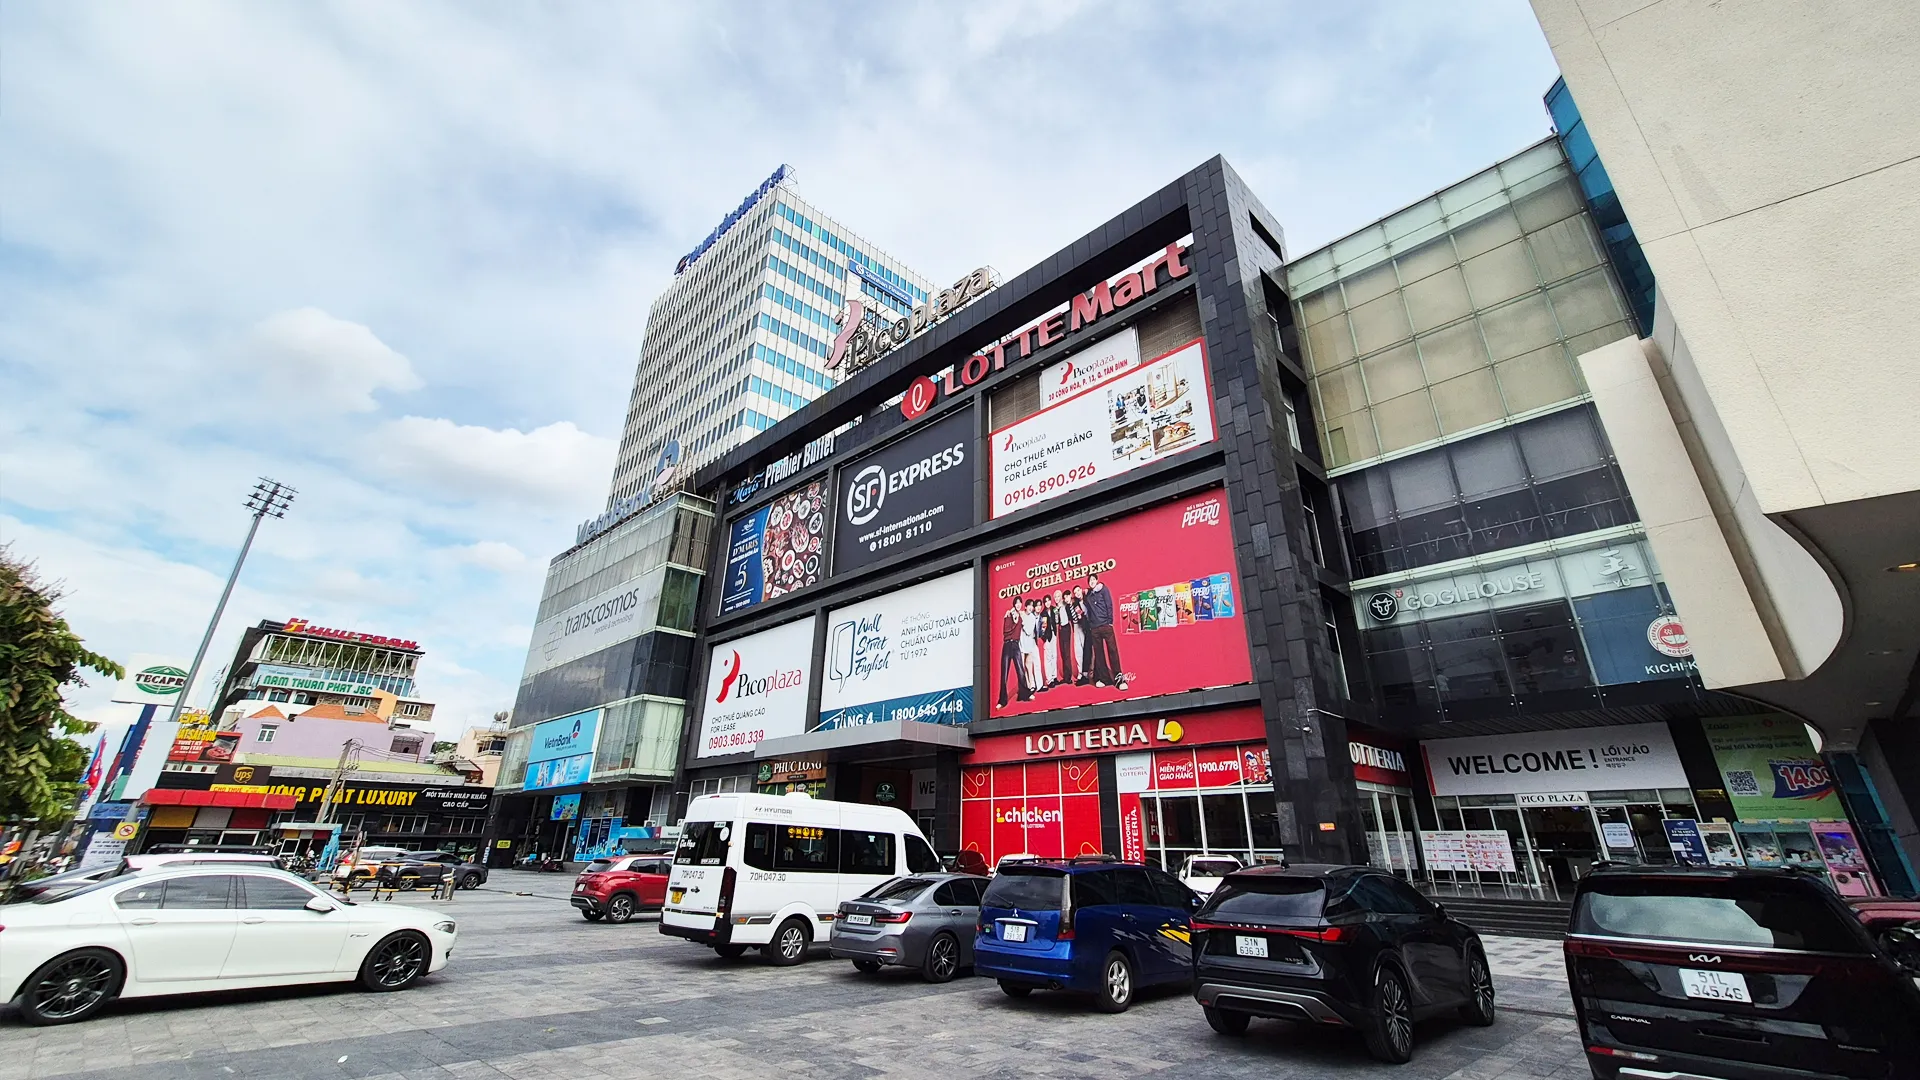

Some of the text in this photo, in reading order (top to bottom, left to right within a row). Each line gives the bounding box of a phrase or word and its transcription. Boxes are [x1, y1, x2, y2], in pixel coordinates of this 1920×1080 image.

[865, 271, 909, 302] Shinhan Finance
[945, 242, 1190, 396] LOTTE Mart
[1048, 393, 1054, 402] 20
[1004, 429, 1093, 472] CHO THUÊ MẶT BẰNG
[764, 452, 803, 489] Premier
[888, 442, 965, 494] EXPRESS
[1004, 460, 1048, 484] FOR LEASE
[1004, 461, 1097, 507] 0916.890.926
[858, 504, 945, 544] www.sf-international.com
[1181, 502, 1220, 529] PEPERO
[877, 521, 932, 549] 1800 8110
[1000, 561, 1016, 570] LOTTE
[1025, 554, 1083, 579] CÙNG VUI
[998, 558, 1117, 599] CÙNG CHIA PEPERO
[1612, 577, 1632, 588] YU
[1404, 571, 1546, 611] GOGI HOUSE
[564, 587, 640, 637] transcosmos
[857, 613, 882, 635] Wall
[900, 610, 975, 638] ANH NGỮ TOÀN CẦU
[927, 631, 948, 644] CHÂU
[948, 627, 960, 638] ÂU
[856, 635, 889, 656] Street
[910, 647, 928, 659] 1972
[1667, 646, 1691, 654] HOTPO
[854, 650, 891, 681] English
[135, 673, 188, 687] TECAPR
[263, 675, 373, 696] NAM THUAN PHAT JSC
[735, 669, 802, 699] Picoplaza
[711, 715, 722, 725] CHO
[722, 711, 735, 723] THUÊ
[890, 705, 916, 721] 1800
[710, 722, 736, 734] FOR LEASE
[708, 728, 765, 750] 0903.960.339
[1024, 722, 1150, 755] LOTTERIA
[1348, 741, 1406, 772] OTTERIA
[1600, 743, 1650, 756] LỐI VÀO
[1119, 770, 1148, 778] LOTTERIA
[1175, 763, 1187, 773] PHÍ
[1198, 760, 1239, 773] 1900.6778
[236, 771, 253, 782] ups
[1159, 770, 1194, 781] GIAO HÀNG
[919, 780, 935, 795] WE
[356, 789, 418, 807] LUXURY
[1520, 793, 1584, 803] PICO PLAZA
[764, 807, 793, 815] HYUNDAI
[1230, 922, 1267, 930] LEXUS
[1244, 937, 1259, 947] 51N
[1239, 945, 1265, 957] 636.33
[1698, 971, 1728, 986] 51L
[1610, 1013, 1652, 1025] CARNIVAL
